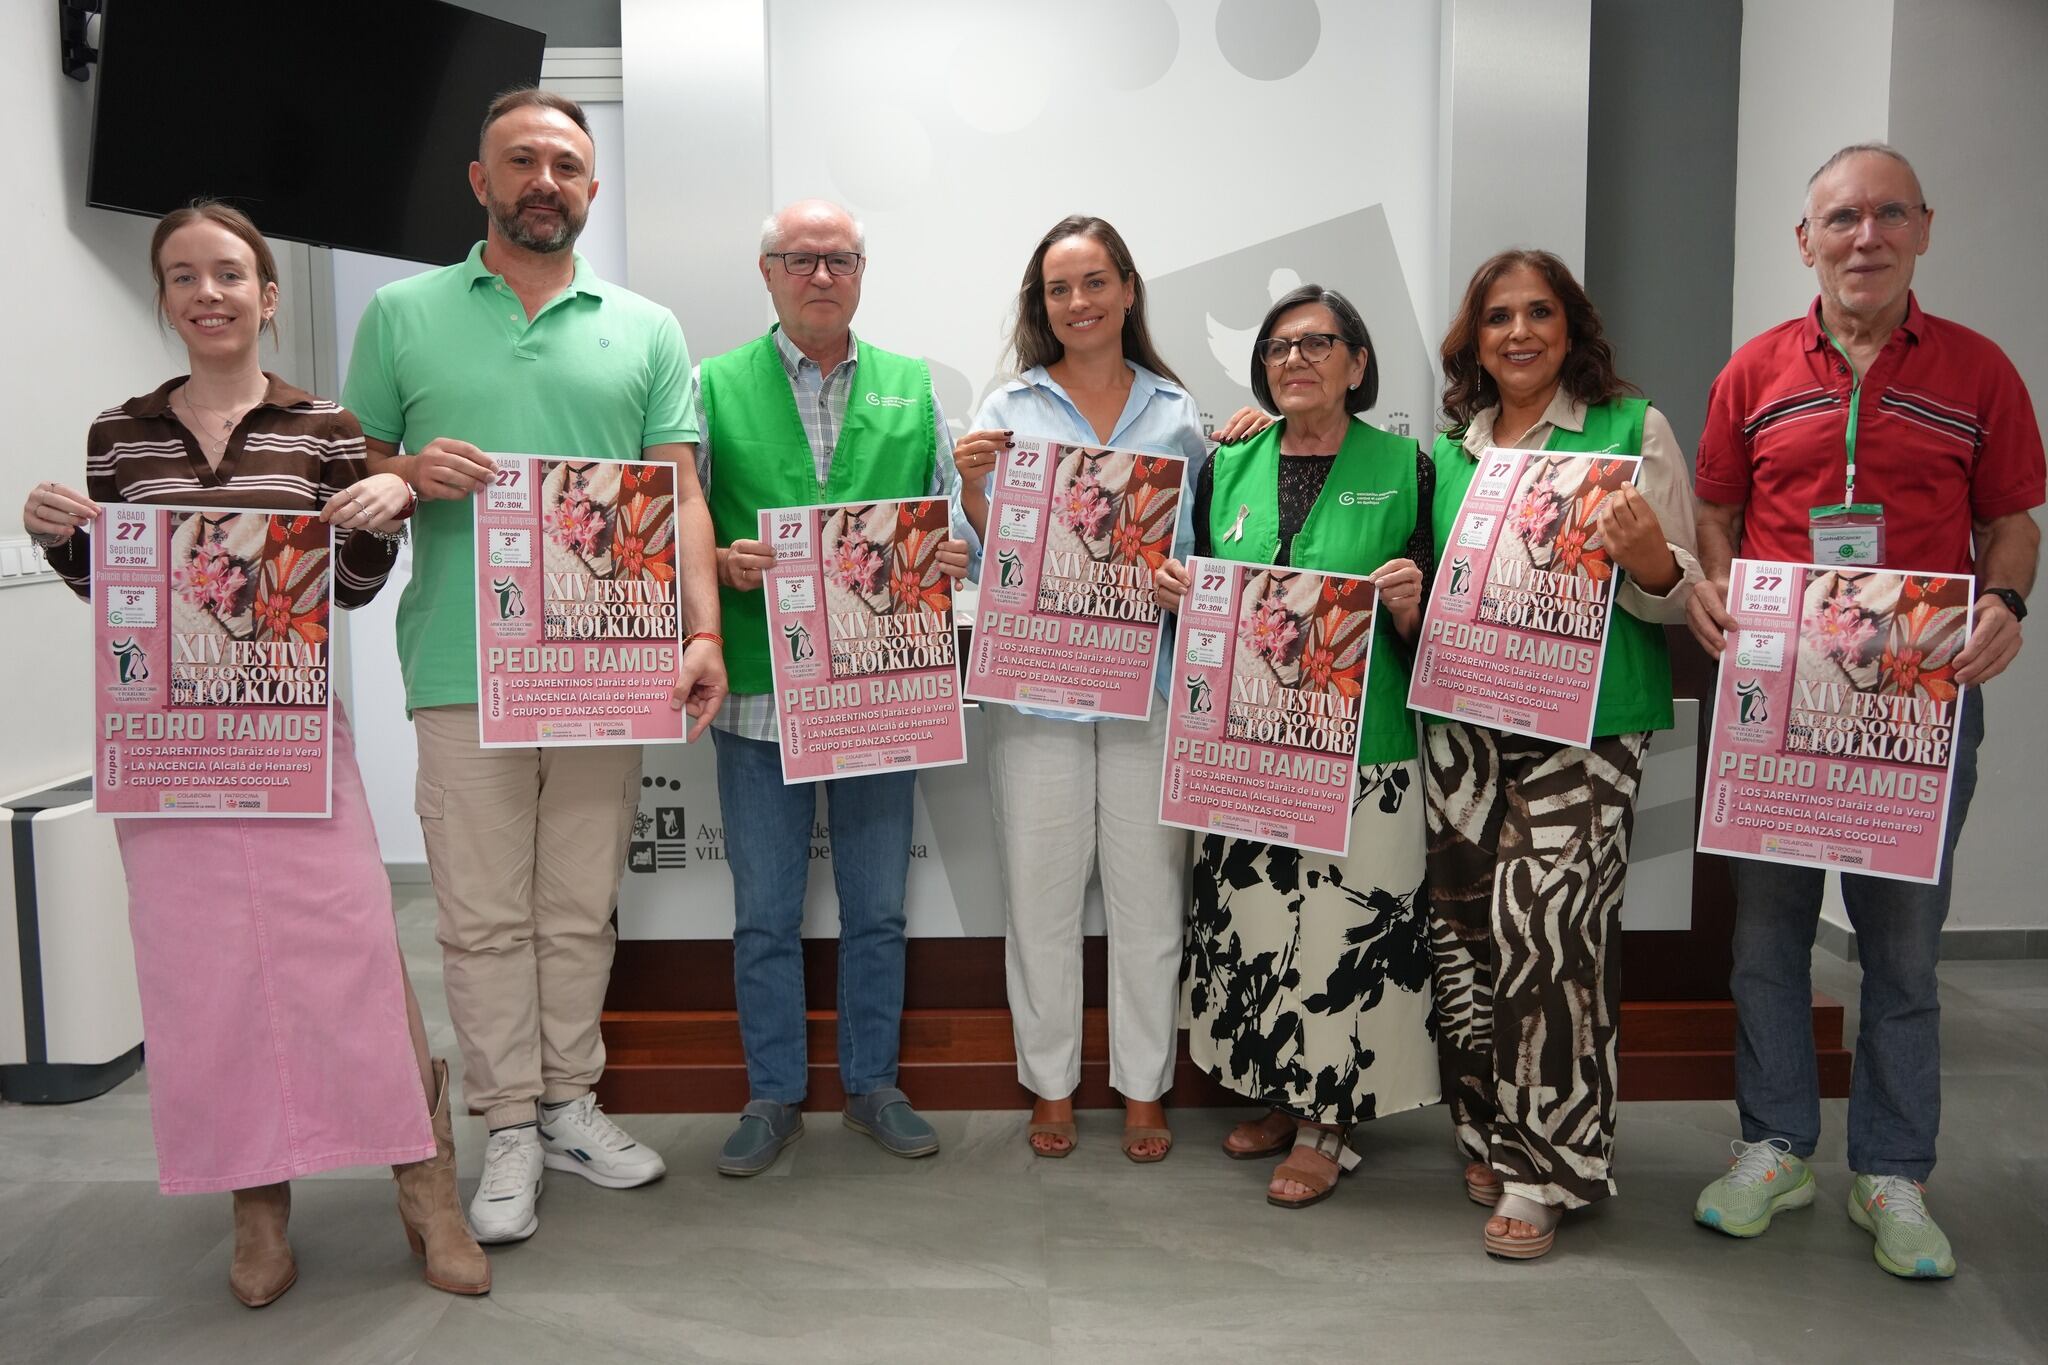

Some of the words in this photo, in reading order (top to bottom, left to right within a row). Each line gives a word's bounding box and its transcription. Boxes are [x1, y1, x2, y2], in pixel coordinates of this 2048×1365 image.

[1015, 450, 1040, 469] 27
[1489, 464, 1512, 479] 27
[495, 470, 521, 488] 27
[116, 522, 146, 541] 27
[779, 522, 803, 539] 27
[547, 572, 592, 601] XIV
[594, 579, 675, 603] FESTIVAL
[1201, 574, 1226, 592] 27
[1527, 568, 1608, 604] FESTIVAL
[1752, 574, 1782, 591] 27
[1057, 591, 1160, 623] FOLKLORE
[1496, 600, 1603, 641] FOLKLORE
[566, 615, 677, 638] FOLKLORE
[874, 610, 951, 637] FESTIVAL
[982, 612, 1061, 643] PEDRO
[1068, 623, 1153, 654] RAMOS
[176, 633, 228, 664] XIV
[231, 640, 326, 667] FESTIVAL
[488, 649, 574, 672] PEDRO
[584, 648, 675, 672] RAMOS
[851, 645, 954, 673] FOLKLORE
[1000, 642, 1017, 651] LOS
[1018, 645, 1074, 659] JARENTINOS
[1127, 658, 1149, 667] Vera)
[1428, 619, 1499, 656] PEDRO
[1504, 634, 1594, 675] RAMOS
[996, 668, 1027, 679] GRUPO
[1029, 672, 1041, 680] DE
[1043, 674, 1079, 685] DANZAS
[1081, 679, 1121, 689] COGOLLA
[998, 655, 1009, 663] LA
[1011, 657, 1057, 669] NACENCIA
[1102, 668, 1139, 679] Henares)
[1442, 651, 1457, 662] LOS
[1458, 655, 1510, 673] JARENTINOS
[1542, 673, 1553, 682] de
[1556, 675, 1564, 684] la
[1566, 677, 1590, 690] Vera)
[197, 679, 326, 705] FOLKLORE
[532, 679, 593, 687] JARENTINOS
[628, 678, 639, 686] de
[642, 678, 650, 686] la
[652, 678, 675, 686] Vera)
[628, 692, 667, 700] Henares)
[785, 684, 862, 713] PEDRO
[869, 674, 954, 705] RAMOS
[1437, 678, 1465, 692] GRUPO
[1466, 685, 1478, 694] DE
[1479, 688, 1515, 702] DANZAS
[1516, 696, 1559, 711] COGOLLA
[1439, 665, 1450, 674] LA
[1451, 667, 1493, 684] NACENCIA
[1526, 684, 1537, 693] de
[1539, 686, 1579, 702] Henares)
[512, 708, 547, 716] GRUPO
[565, 707, 604, 715] DANZAS
[606, 706, 650, 714] COGOLLA
[807, 717, 823, 725] LOS
[825, 711, 879, 724] JARENTINOS
[911, 706, 922, 714] de
[924, 705, 931, 713] la
[933, 702, 954, 712] Vera)
[1277, 686, 1359, 720] FESTIVAL
[1795, 678, 1851, 715] XIV
[1850, 691, 1954, 727] FESTIVAL
[105, 714, 205, 740] PEDRO
[217, 715, 321, 741] RAMOS
[821, 726, 866, 737] NACENCIA
[911, 716, 948, 728] Henares)
[1247, 718, 1355, 755] FOLKLORE
[131, 747, 152, 755] LOS
[155, 747, 226, 755] JARENTINOS
[267, 748, 279, 756] de
[283, 748, 292, 756] la
[295, 748, 321, 757] Vera)
[809, 742, 840, 752] GRUPO
[842, 740, 853, 748] DE
[855, 736, 891, 747] DANZAS
[892, 731, 932, 742] COGOLLA
[1811, 727, 1949, 766] FOLKLORE
[108, 747, 118, 786] Grupos:
[131, 762, 145, 770] LA
[149, 762, 206, 770] NACENCIA
[250, 762, 262, 770] de
[266, 763, 311, 771] Henares)
[1173, 737, 1251, 772] PEDRO
[1259, 751, 1348, 787] RAMOS
[131, 777, 171, 785] GRUPO
[174, 777, 188, 785] DE
[192, 777, 237, 785] DANZAS
[240, 777, 290, 785] COGOLLA
[1191, 769, 1208, 778] LOS
[1210, 772, 1265, 788] JARENTINOS
[1298, 786, 1309, 795] de
[1312, 788, 1319, 797] la
[1321, 790, 1344, 801] Vera)
[1718, 752, 1817, 789] PEDRO
[1826, 765, 1940, 804] RAMOS
[1189, 794, 1219, 806] GRUPO
[1222, 800, 1233, 809] DE
[1235, 803, 1272, 815] DANZAS
[1273, 809, 1315, 822] COGOLLA
[1190, 782, 1201, 790] LA
[1203, 784, 1248, 798] NACENCIA
[1282, 797, 1293, 806] de
[1295, 799, 1334, 813] Henares)
[1740, 787, 1762, 798] LOS
[1763, 790, 1834, 807] JARENTINOS
[1875, 804, 1890, 814] de
[1893, 806, 1903, 815] la
[1906, 808, 1935, 820] Vera)
[1737, 817, 1775, 829] GRUPO
[1778, 822, 1793, 832] DE
[1796, 825, 1842, 838] DANZAS
[1844, 831, 1898, 844] COGOLLA
[1739, 802, 1752, 811] LA
[1755, 804, 1812, 819] NACENCIA
[1856, 817, 1870, 826] de
[1872, 819, 1922, 833] Henares)
